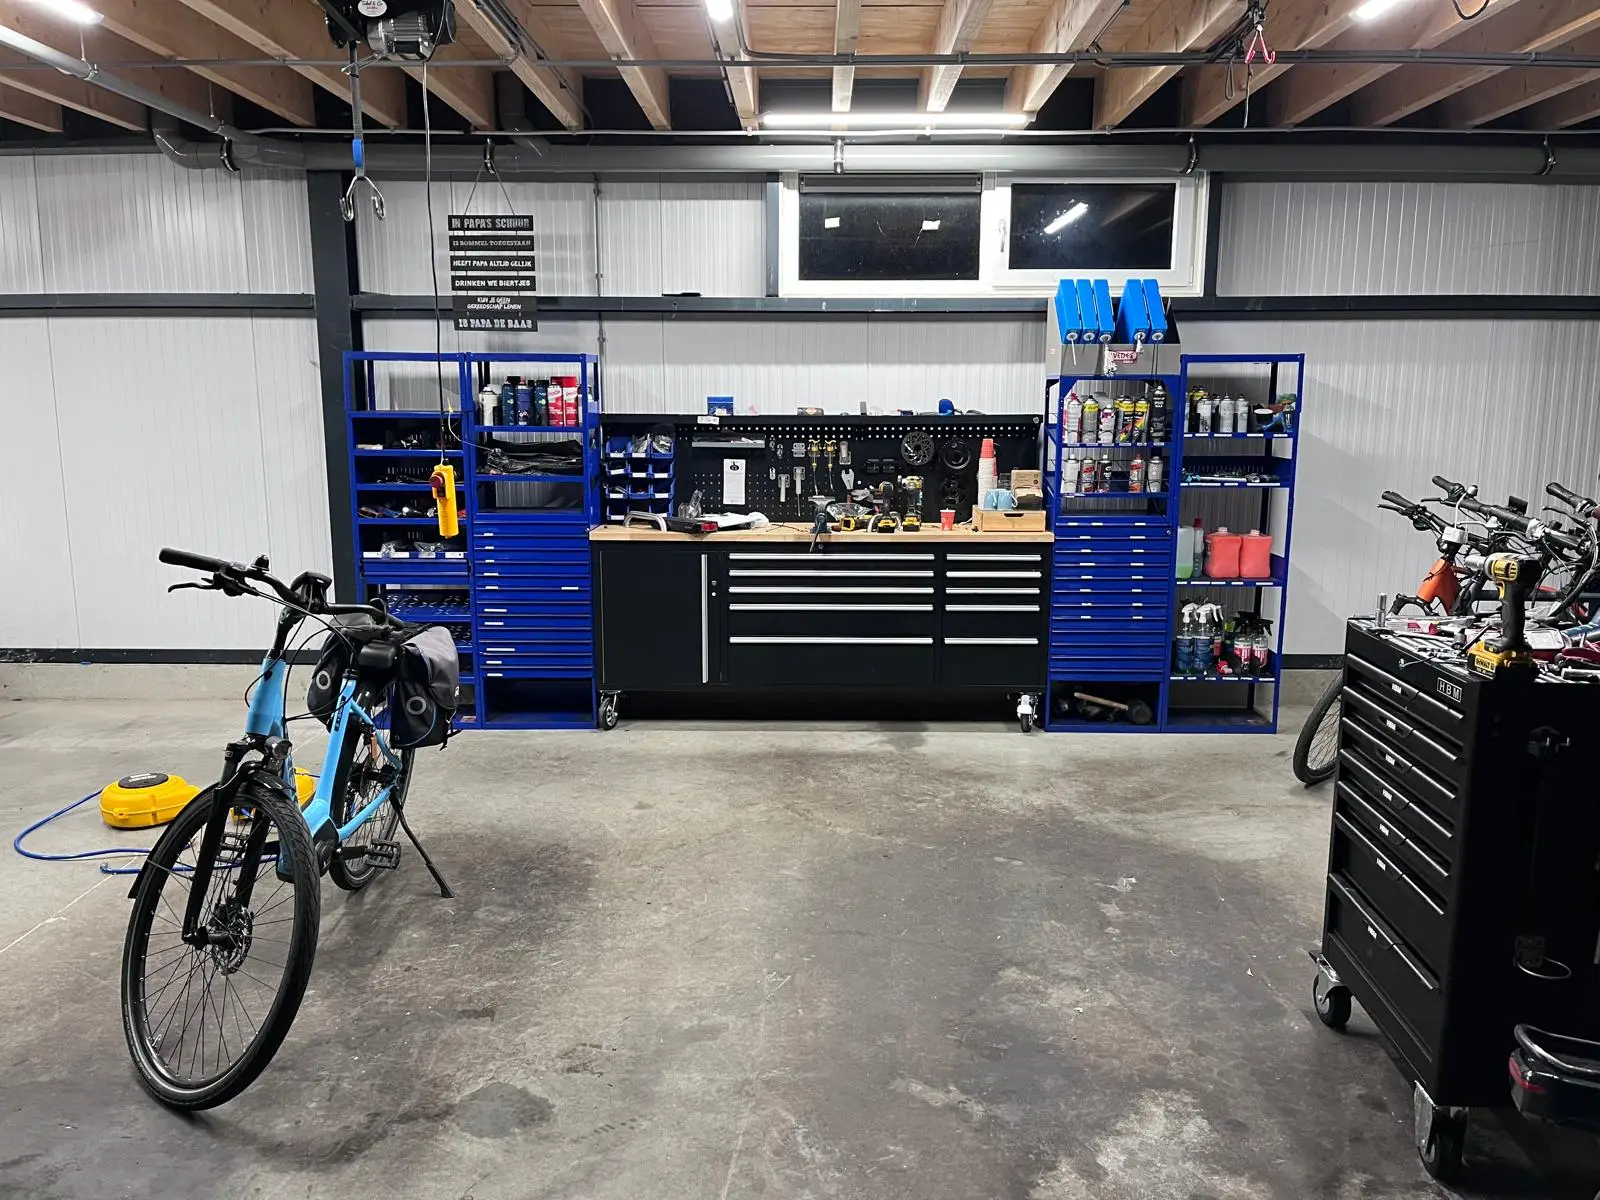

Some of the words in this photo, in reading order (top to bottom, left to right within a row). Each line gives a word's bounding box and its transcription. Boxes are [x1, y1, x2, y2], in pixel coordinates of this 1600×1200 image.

[452, 218, 461, 229] IN
[464, 218, 492, 229] PAPA'S
[495, 218, 530, 229] SCHUUR
[458, 319, 468, 328] IS
[470, 319, 492, 328] PAPA
[493, 319, 506, 328] DE
[507, 319, 533, 329] BAAS
[1439, 681, 1460, 700] HBM
